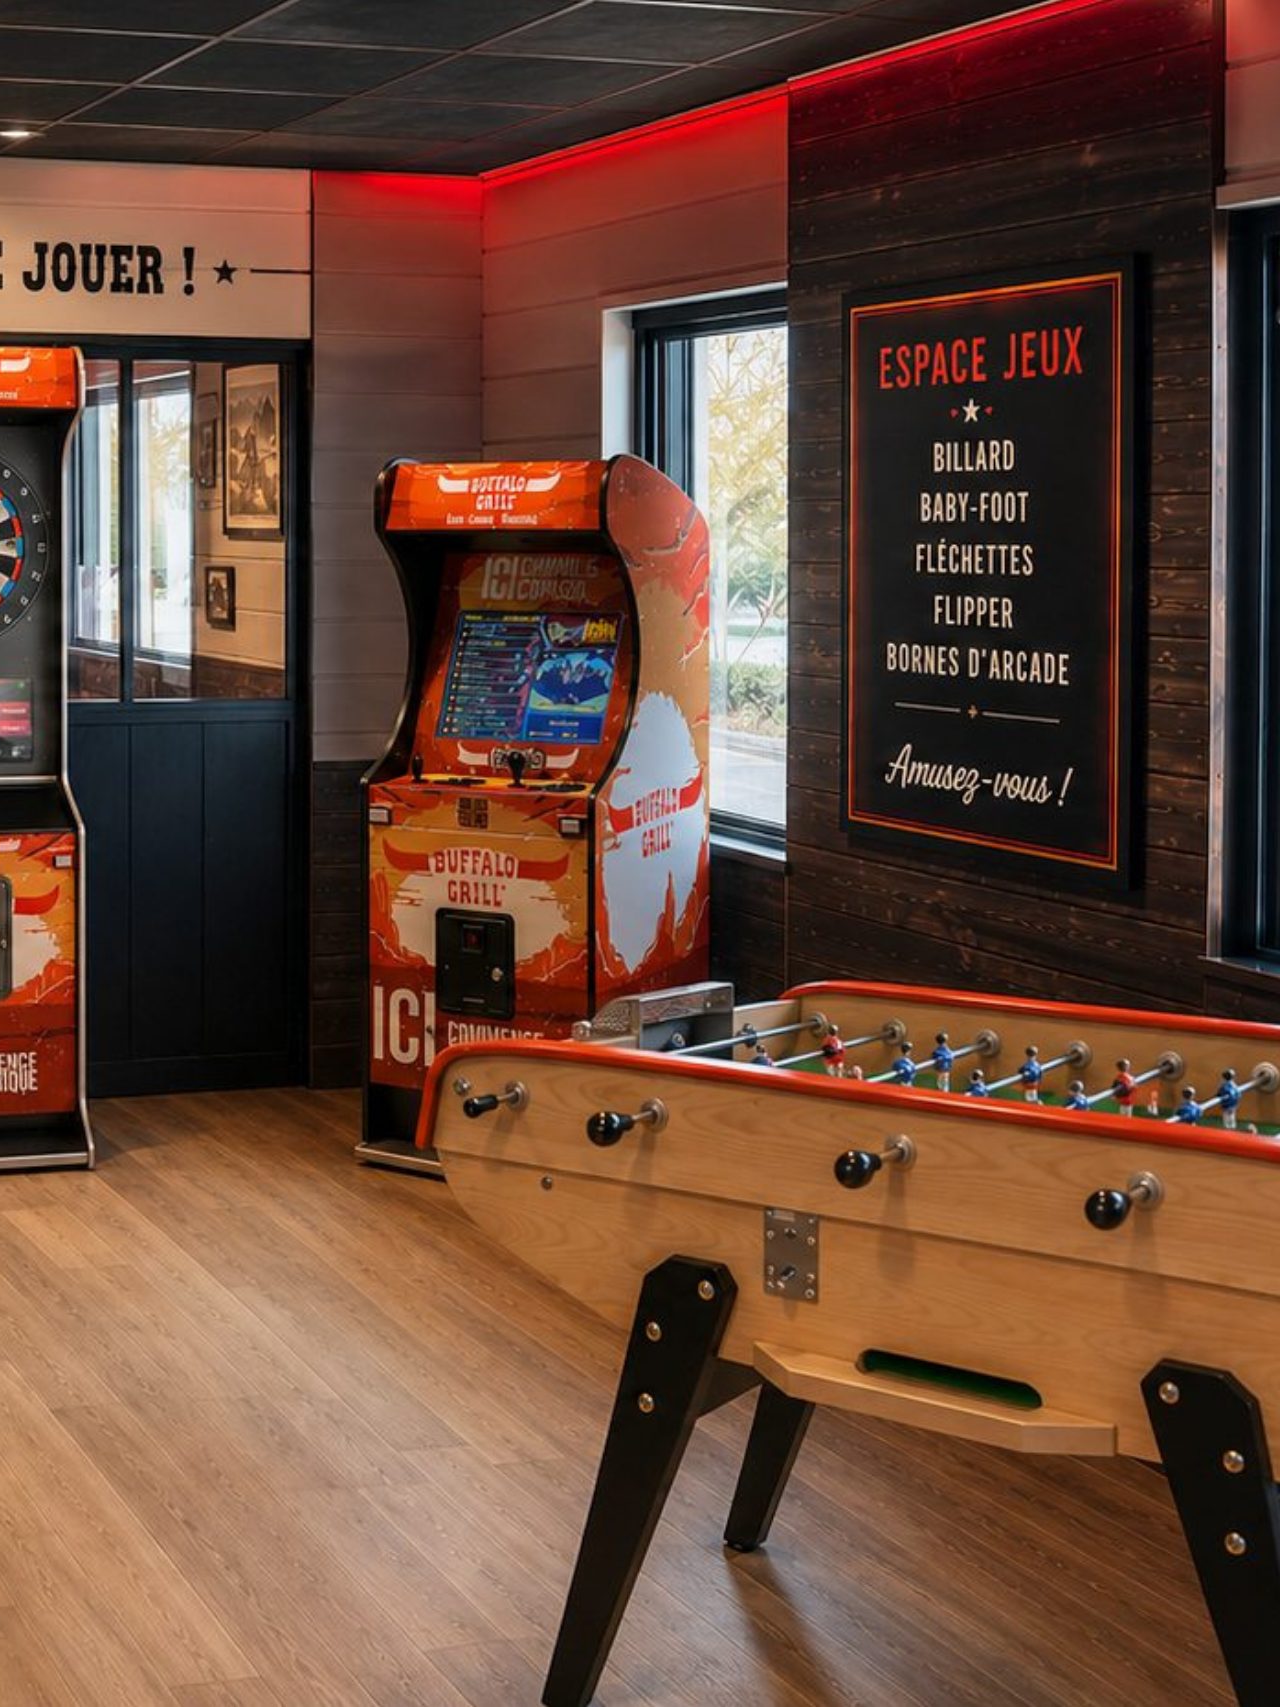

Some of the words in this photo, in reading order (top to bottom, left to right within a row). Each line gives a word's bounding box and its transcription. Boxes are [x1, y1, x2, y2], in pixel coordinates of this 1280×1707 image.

[23, 242, 164, 294] JOUER
[182, 247, 195, 295] !
[879, 336, 987, 389] ESPACE
[1003, 326, 1083, 380] JEUX
[933, 440, 1015, 472] BILLARD
[920, 491, 1029, 523] BABY-FOOT
[915, 537, 1034, 576] FLÉCHETTES
[933, 595, 1014, 629] FLIPPER
[886, 642, 960, 677] BORNES
[968, 646, 1070, 686] D'ARCADE
[884, 743, 1053, 805] Amusez-vous
[1057, 767, 1074, 806] !
[434, 848, 516, 879] BUFFALO
[448, 880, 502, 907] GRILL
[373, 985, 436, 1066] ICI
